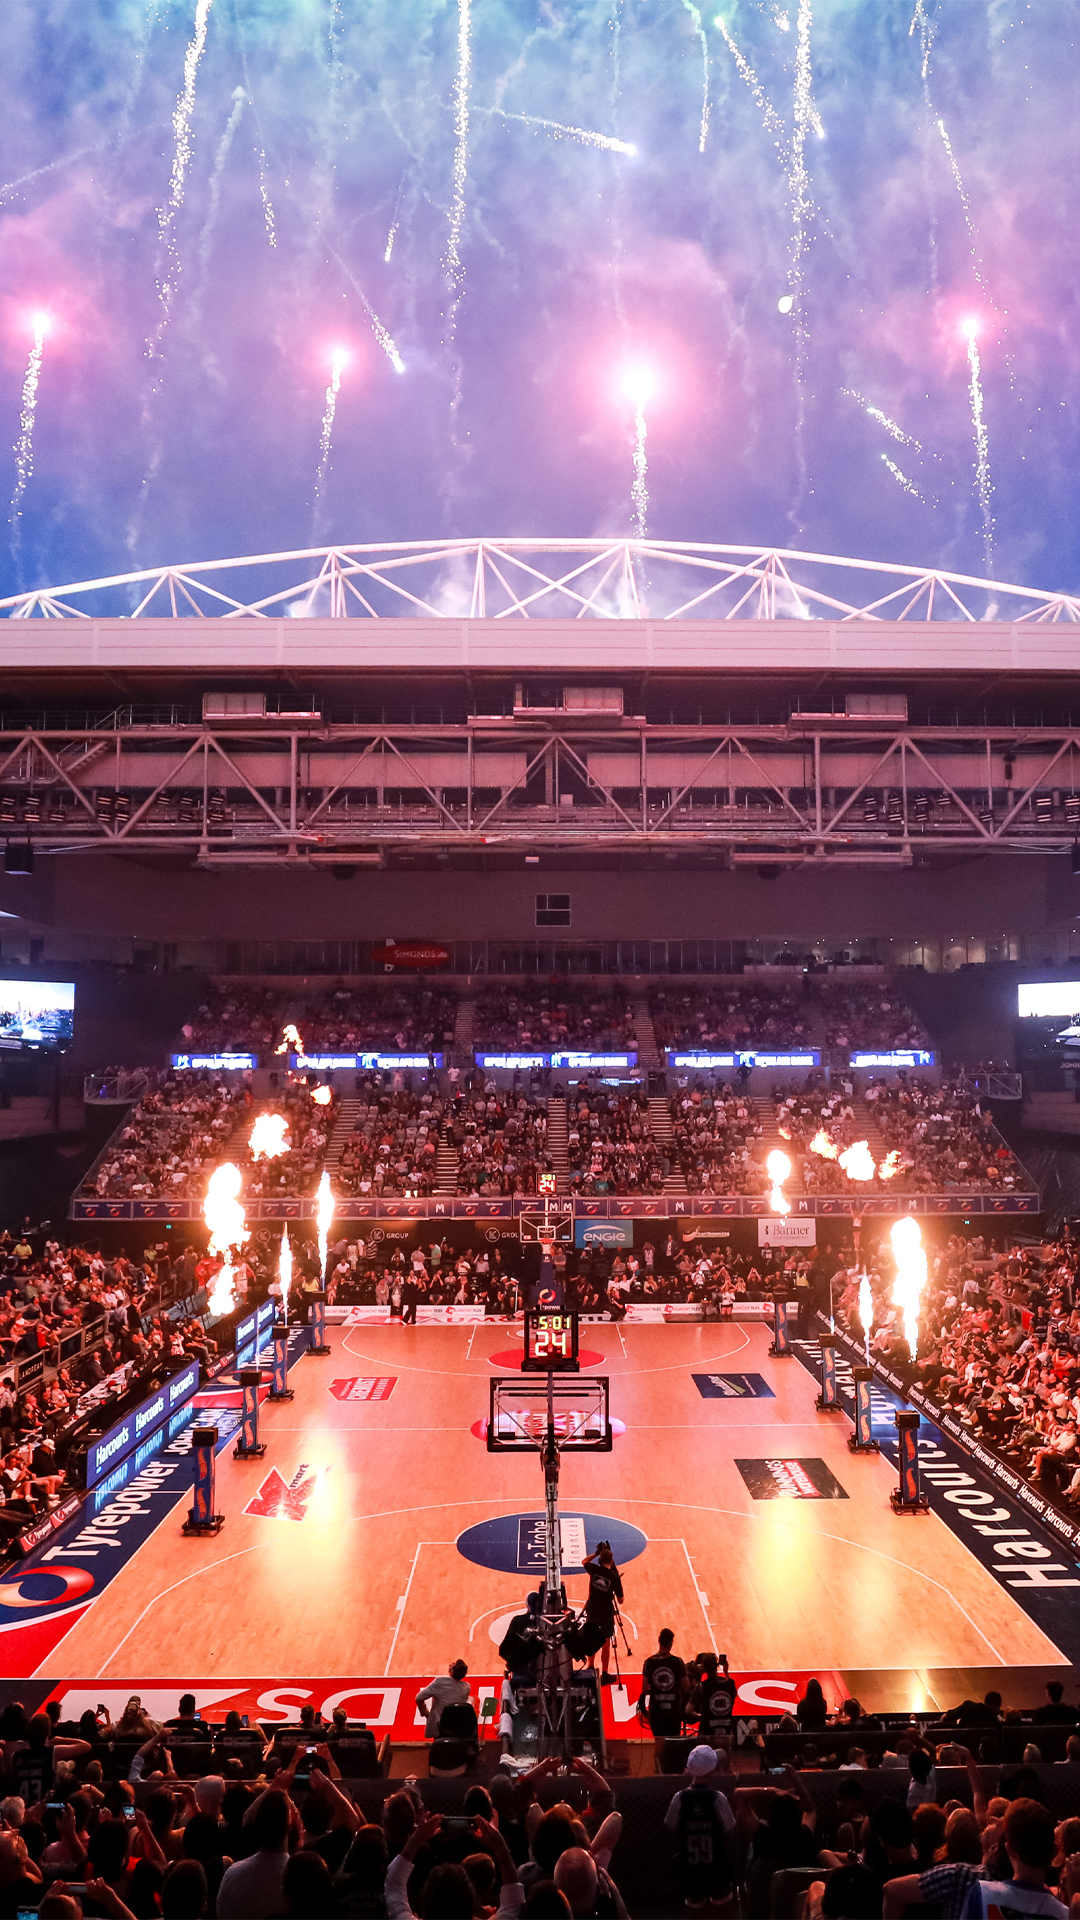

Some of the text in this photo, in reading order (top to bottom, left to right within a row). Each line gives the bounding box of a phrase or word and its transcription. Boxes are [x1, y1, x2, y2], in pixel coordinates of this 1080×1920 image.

[394, 949, 436, 959] SIMONDS
[540, 1180, 555, 1192] 24
[773, 1224, 810, 1236] Banner
[539, 1316, 570, 1330] 5:01
[535, 1331, 566, 1357] 24
[169, 1371, 194, 1402] Harcourts
[135, 1397, 164, 1432] Harcourts
[942, 1414, 961, 1436] Harcourts
[95, 1427, 129, 1468] Harcourts
[973, 1446, 997, 1470] Harcourts
[289, 1464, 309, 1488] mart
[994, 1463, 1020, 1490] Harcourts
[41, 1461, 180, 1561] Tyrepower
[1019, 1484, 1046, 1513] Harcourts
[1044, 1507, 1074, 1538] Harcourts
[18, 1778, 42, 1805] 43
[686, 1833, 714, 1866] 59
